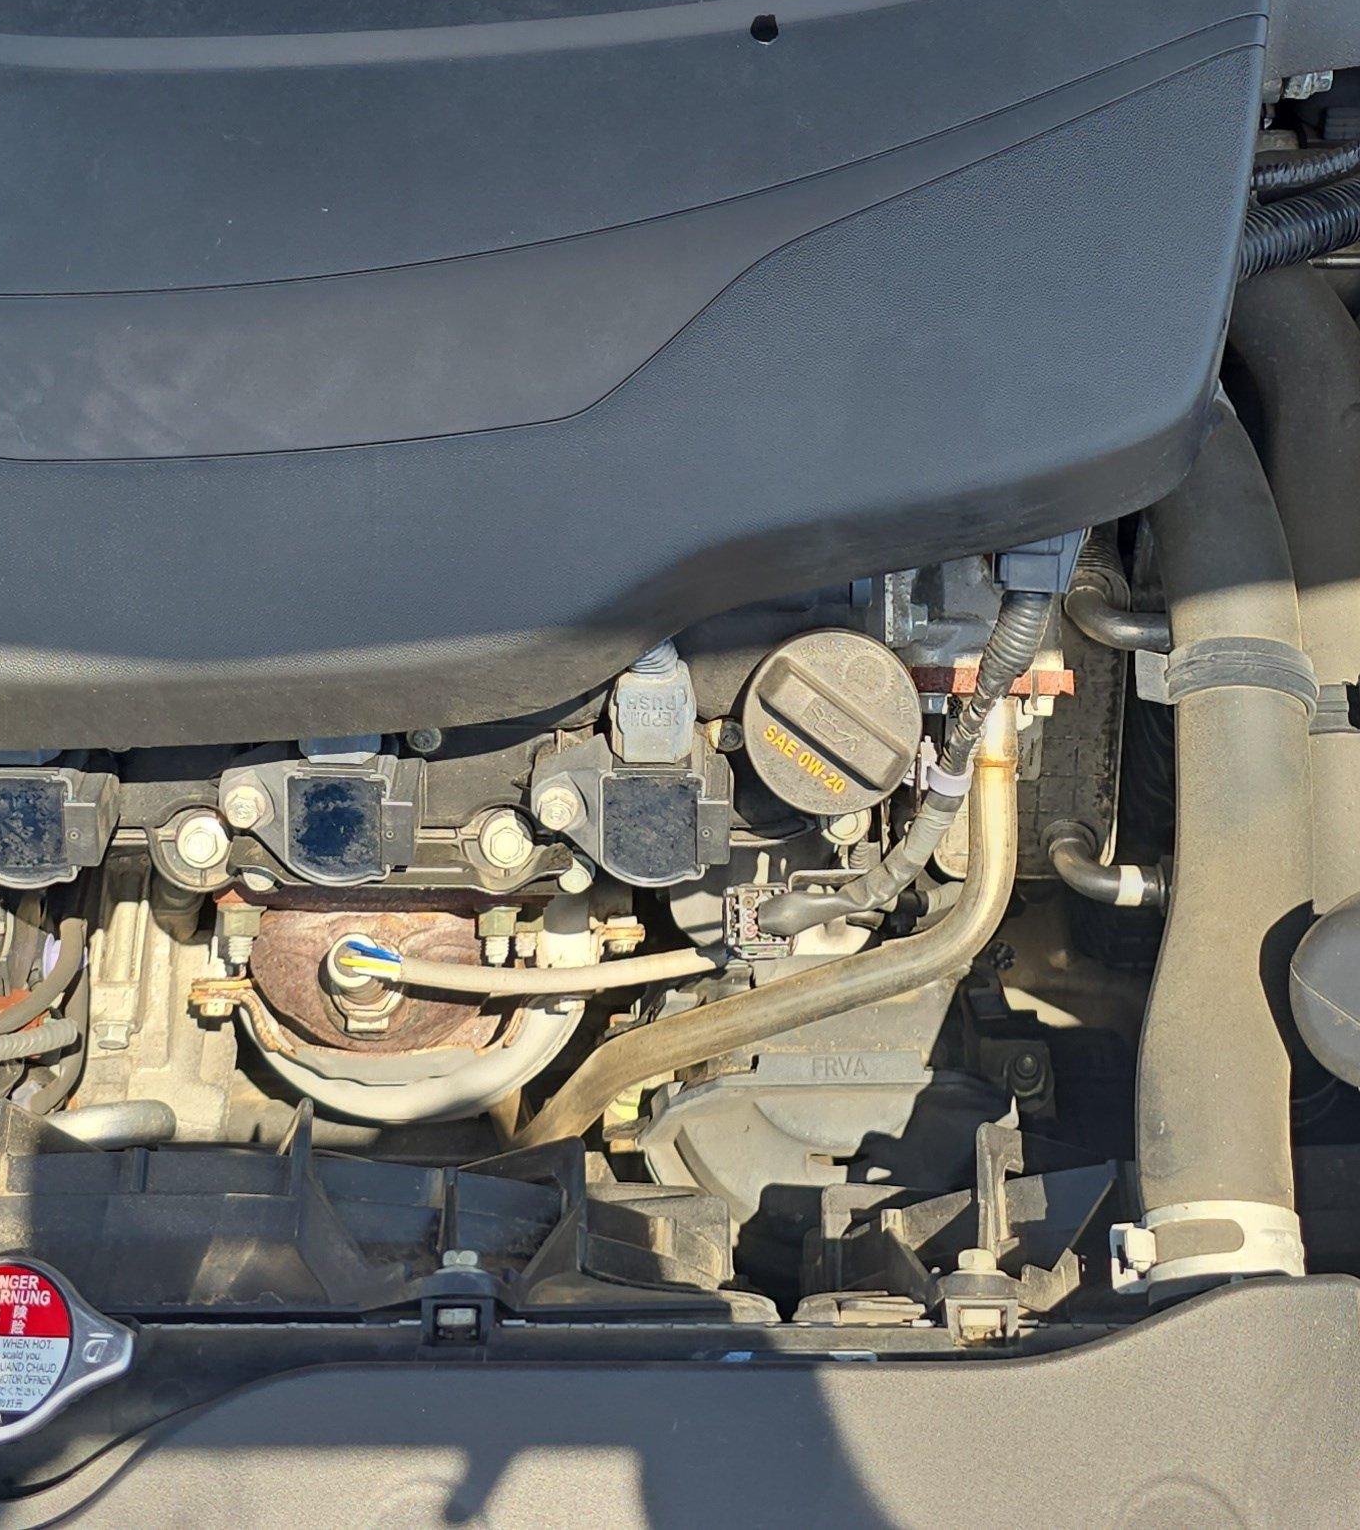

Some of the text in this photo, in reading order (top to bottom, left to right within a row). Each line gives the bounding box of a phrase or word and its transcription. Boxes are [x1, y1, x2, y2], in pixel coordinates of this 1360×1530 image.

[626, 695, 678, 710] PUSH
[763, 724, 847, 795] SAE 0W-20
[2, 1339, 29, 1349] WHEN
[32, 1340, 54, 1350] HOT.
[2, 1351, 23, 1360] scald
